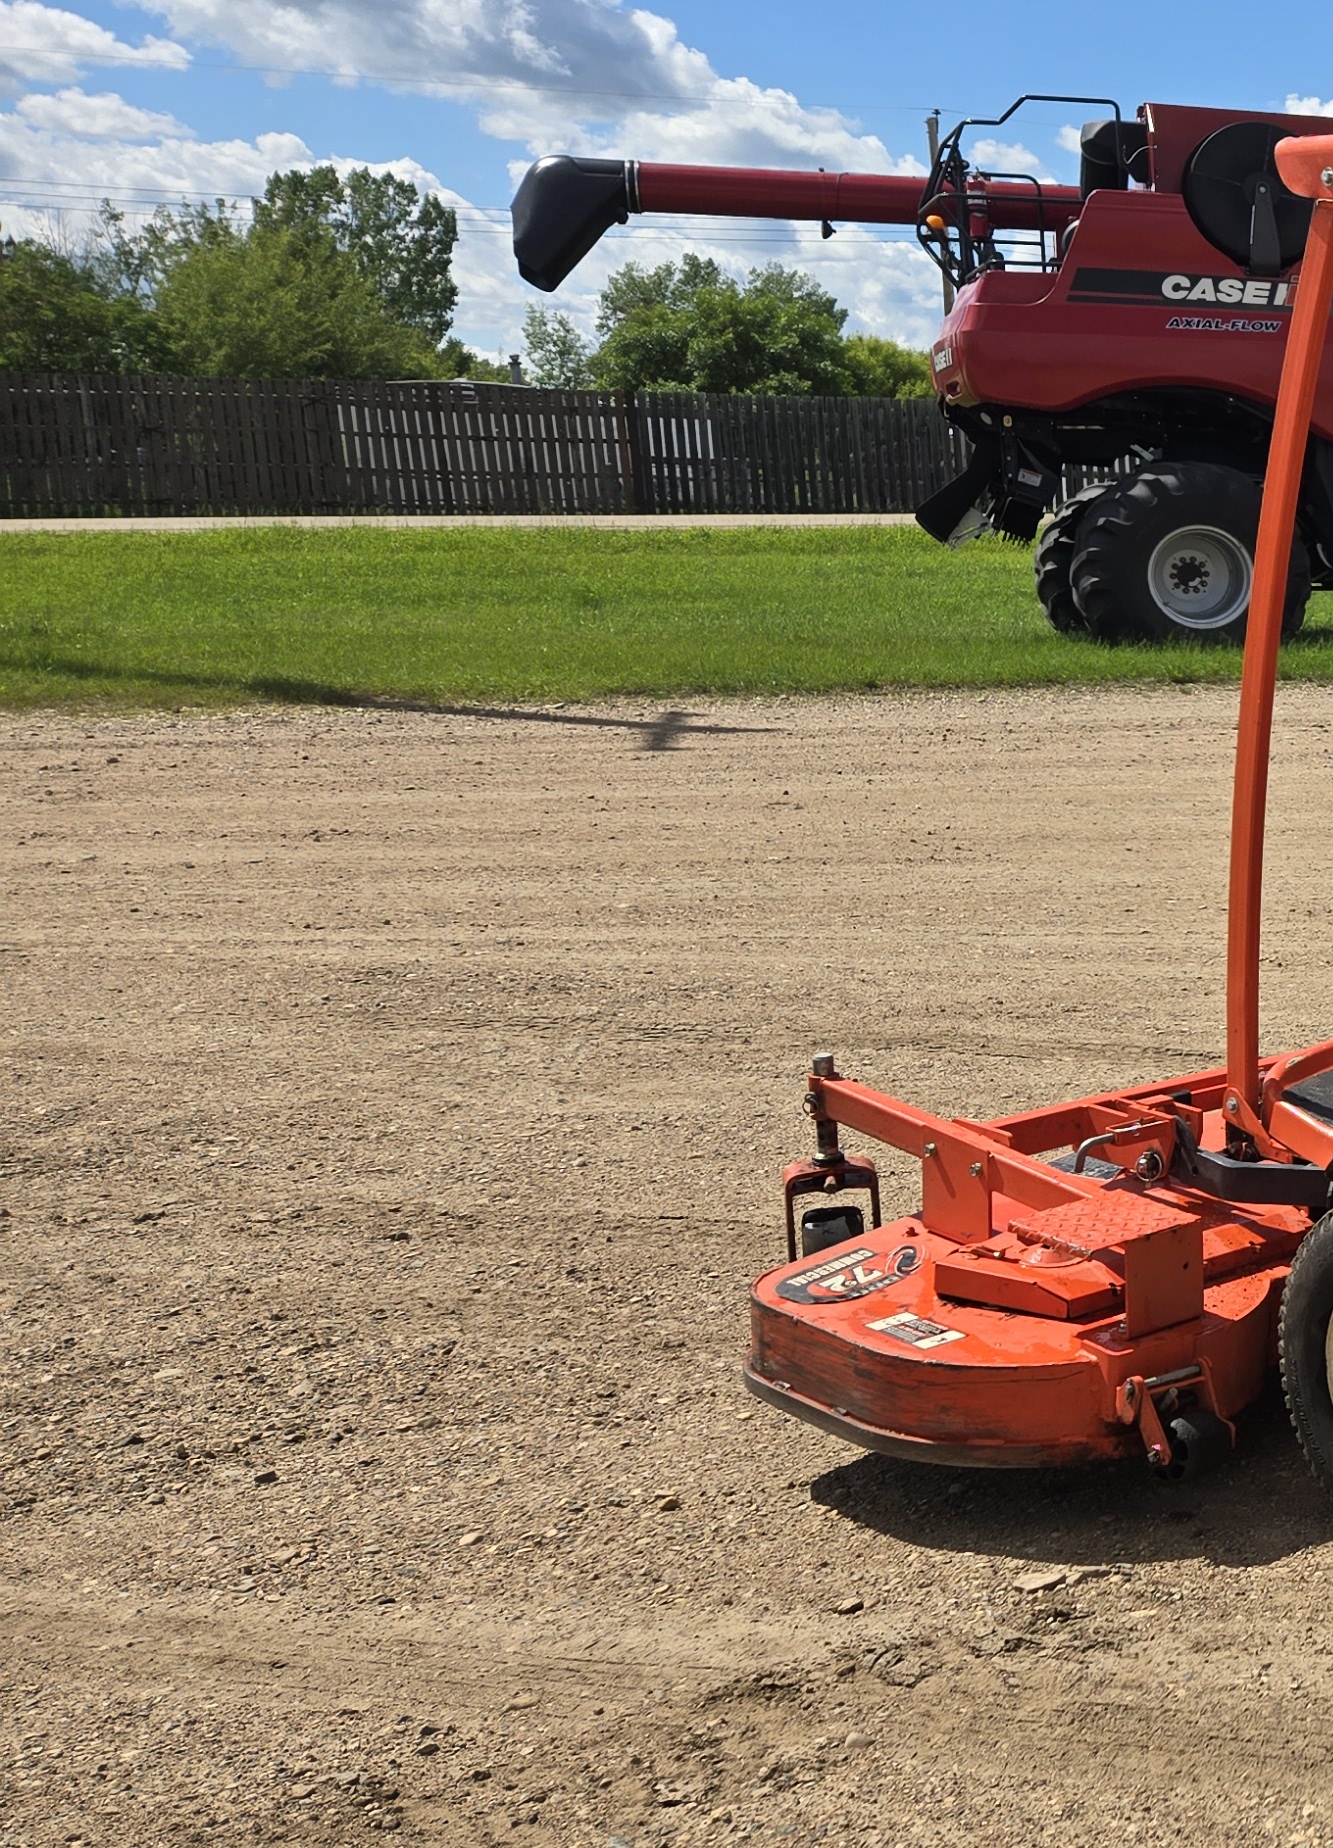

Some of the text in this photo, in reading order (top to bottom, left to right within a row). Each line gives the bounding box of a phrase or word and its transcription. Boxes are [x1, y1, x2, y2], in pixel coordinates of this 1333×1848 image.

[1161, 274, 1271, 305] CASE
[1165, 316, 1282, 333] AXIAL-FLOW
[786, 1249, 875, 1287] COMMERCIAL
[818, 1265, 883, 1293] 72
